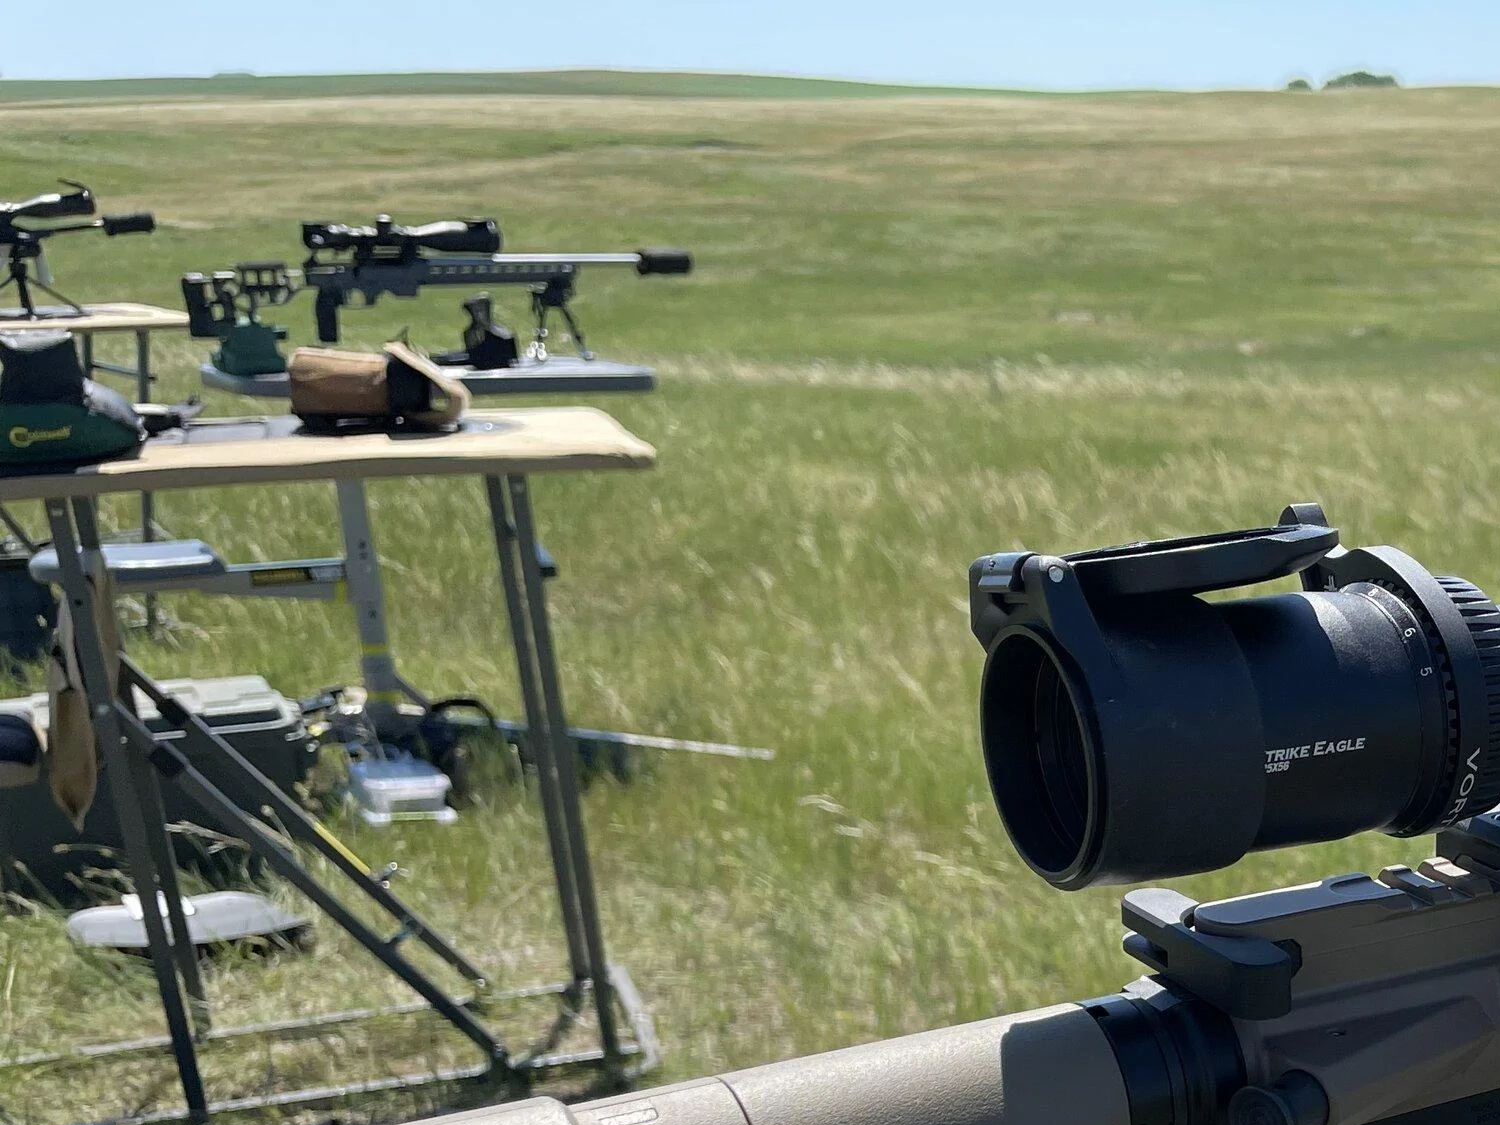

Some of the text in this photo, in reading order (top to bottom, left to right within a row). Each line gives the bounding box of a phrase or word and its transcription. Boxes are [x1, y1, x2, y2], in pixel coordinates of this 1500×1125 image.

[1404, 627, 1416, 638] 6
[1420, 666, 1433, 677] 5
[1265, 737, 1366, 763] TRIKE EAGLE
[1265, 760, 1291, 774] 5X56
